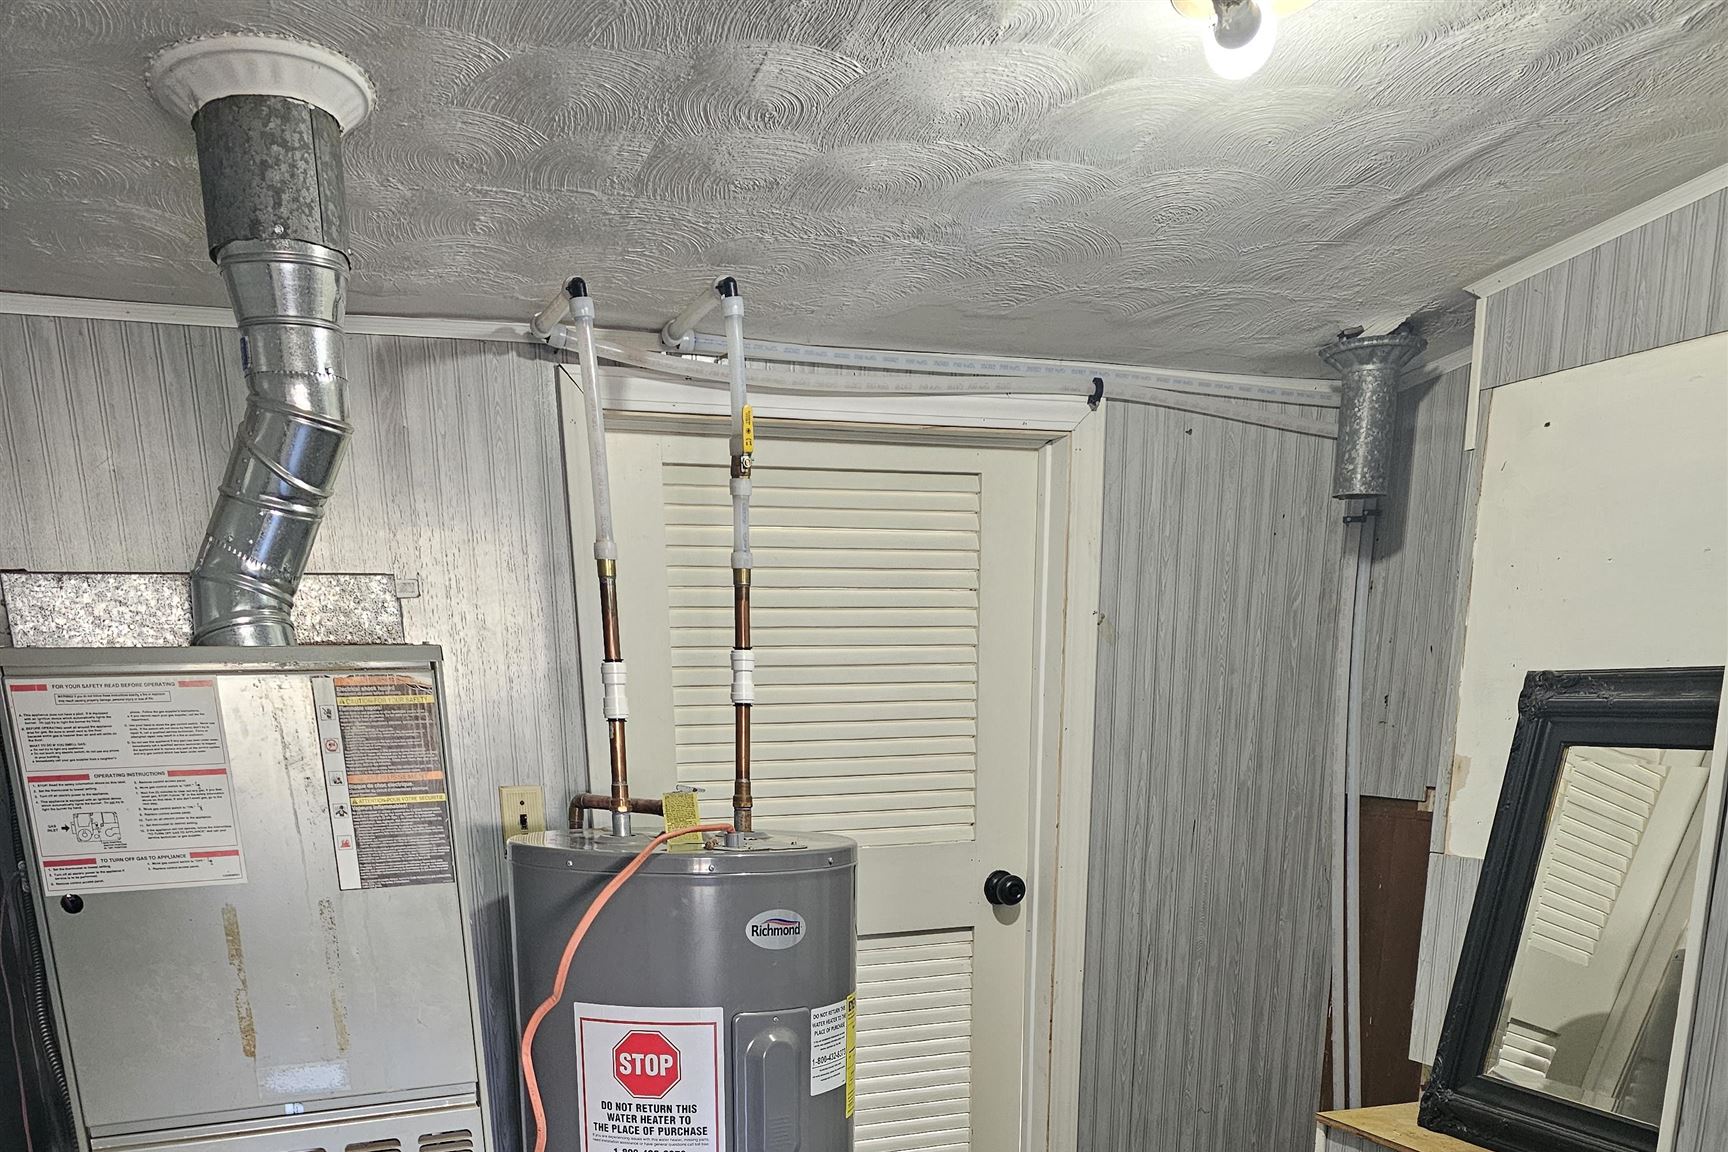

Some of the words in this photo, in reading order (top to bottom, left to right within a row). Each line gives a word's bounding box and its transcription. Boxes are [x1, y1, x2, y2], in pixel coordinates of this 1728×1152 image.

[751, 922, 800, 937] Richmond
[812, 1020, 825, 1028] WATER
[826, 1017, 837, 1026] HEATER
[814, 1028, 826, 1036] PLACE
[831, 1022, 845, 1031] PURCHASE
[619, 1053, 673, 1076] STOP
[601, 1101, 612, 1110] DO
[616, 1102, 633, 1112] NOT
[636, 1104, 672, 1113] RETURN
[676, 1104, 697, 1114] THIS
[607, 1113, 637, 1123] WATER
[640, 1115, 676, 1124] HEATER
[679, 1116, 691, 1125] TO
[593, 1122, 609, 1132] THE
[612, 1124, 640, 1135] PLACE
[643, 1126, 654, 1135] OF
[658, 1127, 708, 1136] PURCHASE
